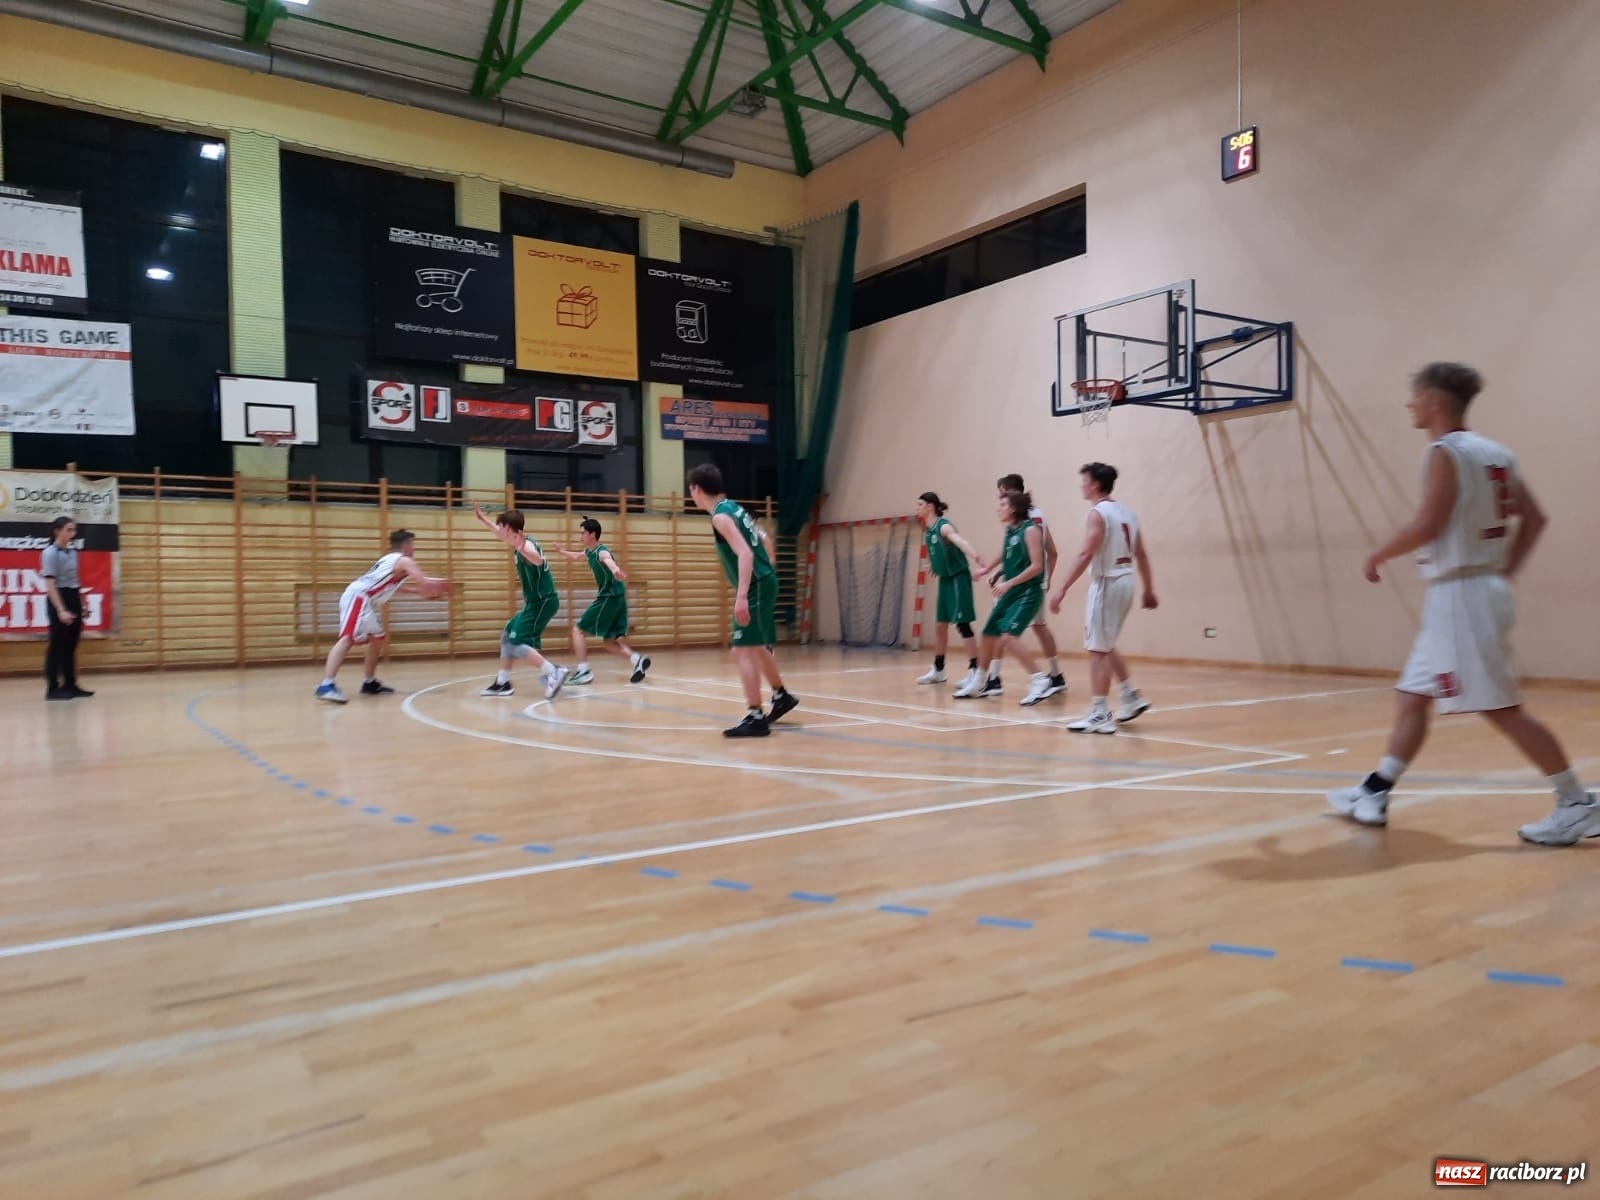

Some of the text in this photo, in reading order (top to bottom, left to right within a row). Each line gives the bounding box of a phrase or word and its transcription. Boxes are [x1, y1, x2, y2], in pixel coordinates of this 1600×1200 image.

[1238, 146, 1251, 170] 6
[0, 327, 120, 345] THIS GAME
[670, 400, 715, 416] ARES
[14, 486, 114, 505] Dobrodzień
